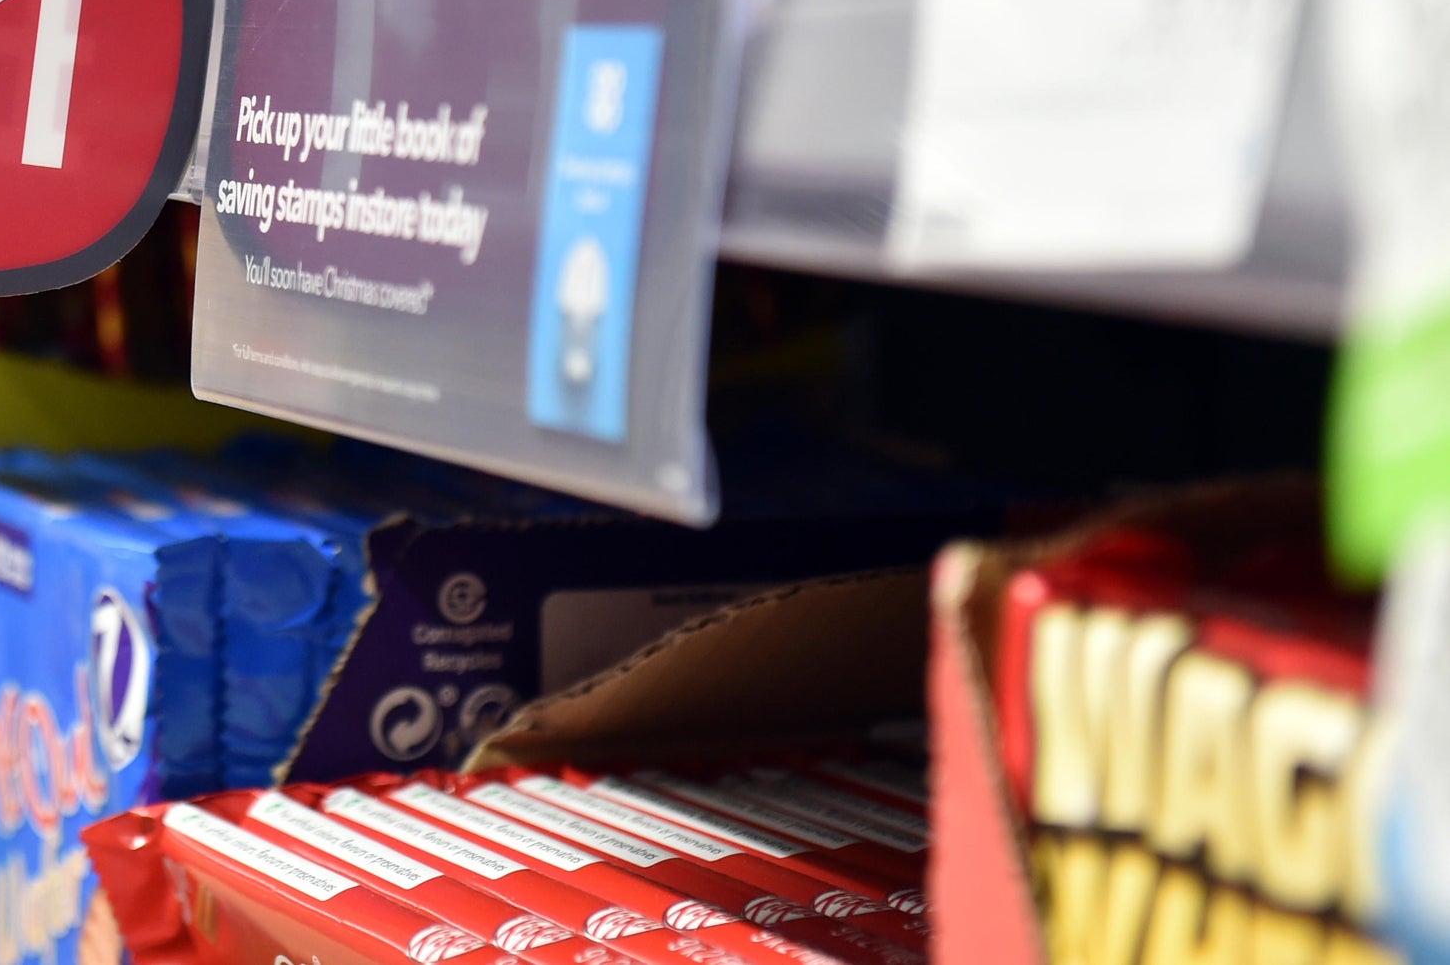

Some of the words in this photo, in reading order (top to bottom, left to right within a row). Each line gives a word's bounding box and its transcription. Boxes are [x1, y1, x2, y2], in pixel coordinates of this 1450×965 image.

[236, 95, 275, 145] Pick
[275, 110, 302, 162] up
[299, 111, 350, 163] your
[347, 97, 395, 157] little
[394, 100, 454, 163] book
[452, 102, 490, 166] of
[216, 167, 276, 233] saving
[275, 179, 346, 243] stamps
[345, 177, 419, 240] instore
[417, 185, 490, 265] today
[245, 254, 271, 286] You'll
[270, 266, 296, 291] soon
[297, 260, 324, 297] have
[323, 265, 378, 308] Christmas
[453, 847, 509, 873] preservatives
[526, 839, 585, 864] preservatives
[284, 867, 338, 893] preservatives
[368, 856, 422, 882] preservatives
